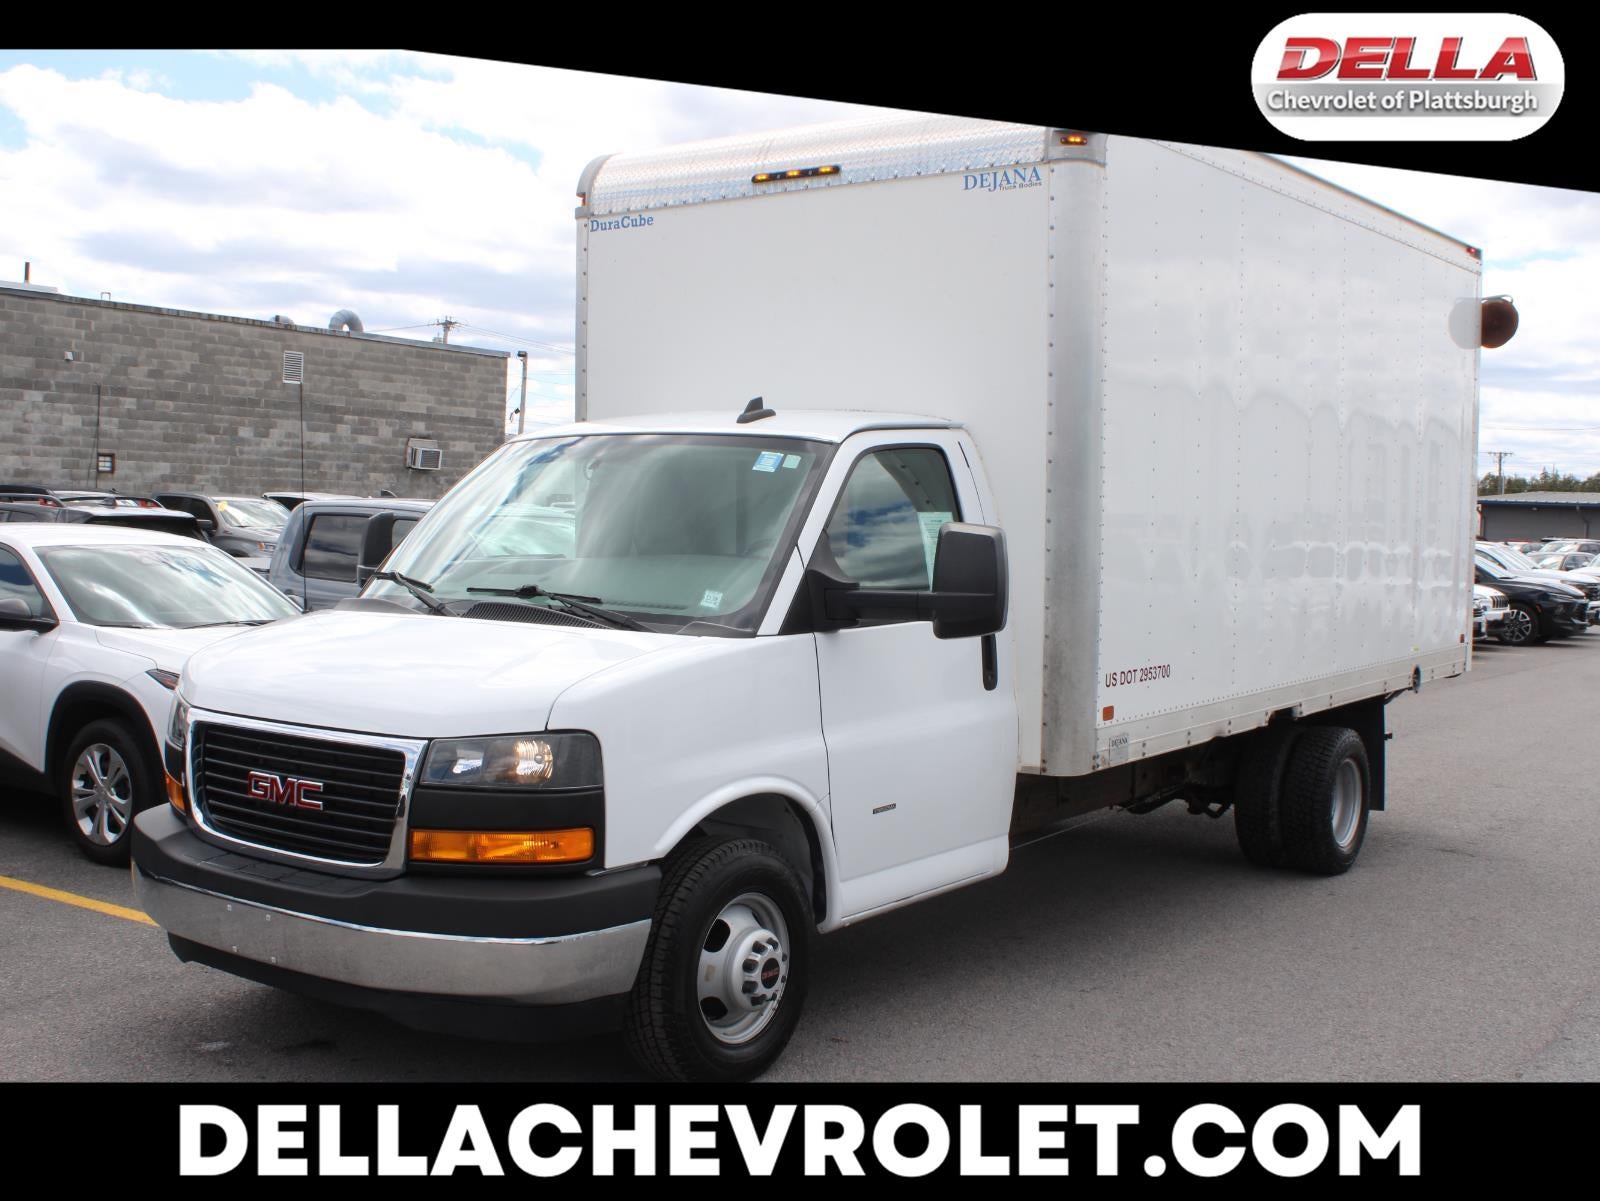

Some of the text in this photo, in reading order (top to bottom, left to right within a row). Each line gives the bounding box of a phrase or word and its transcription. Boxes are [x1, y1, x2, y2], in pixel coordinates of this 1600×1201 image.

[963, 166, 1041, 192] DEJANA
[590, 214, 654, 232] DuraCube
[1105, 663, 1171, 688] US DOT 2953700
[247, 770, 324, 811] GMC
